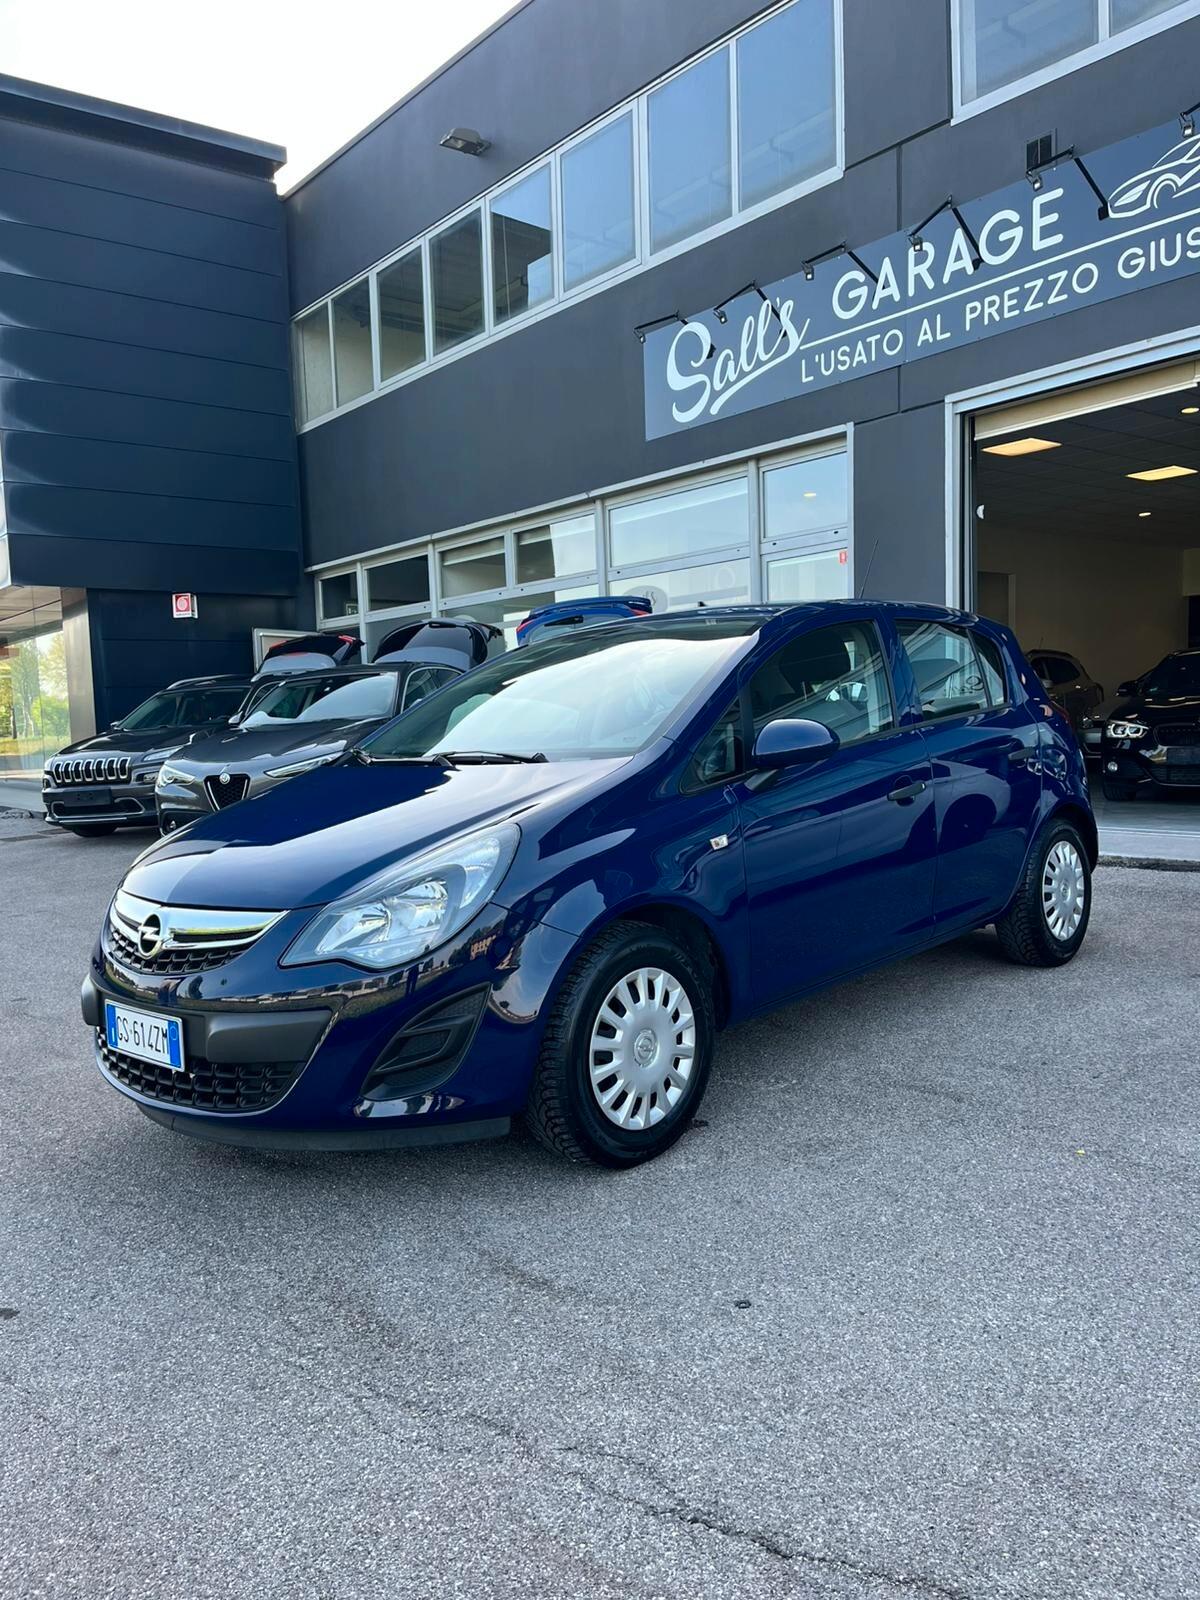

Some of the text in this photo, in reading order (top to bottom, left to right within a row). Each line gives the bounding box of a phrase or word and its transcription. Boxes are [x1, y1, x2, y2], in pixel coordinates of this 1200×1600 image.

[667, 188, 1064, 423] Sall's GARAGE
[801, 329, 904, 383] L'USATO
[917, 314, 951, 347] AL
[966, 263, 1099, 332] PREZZO
